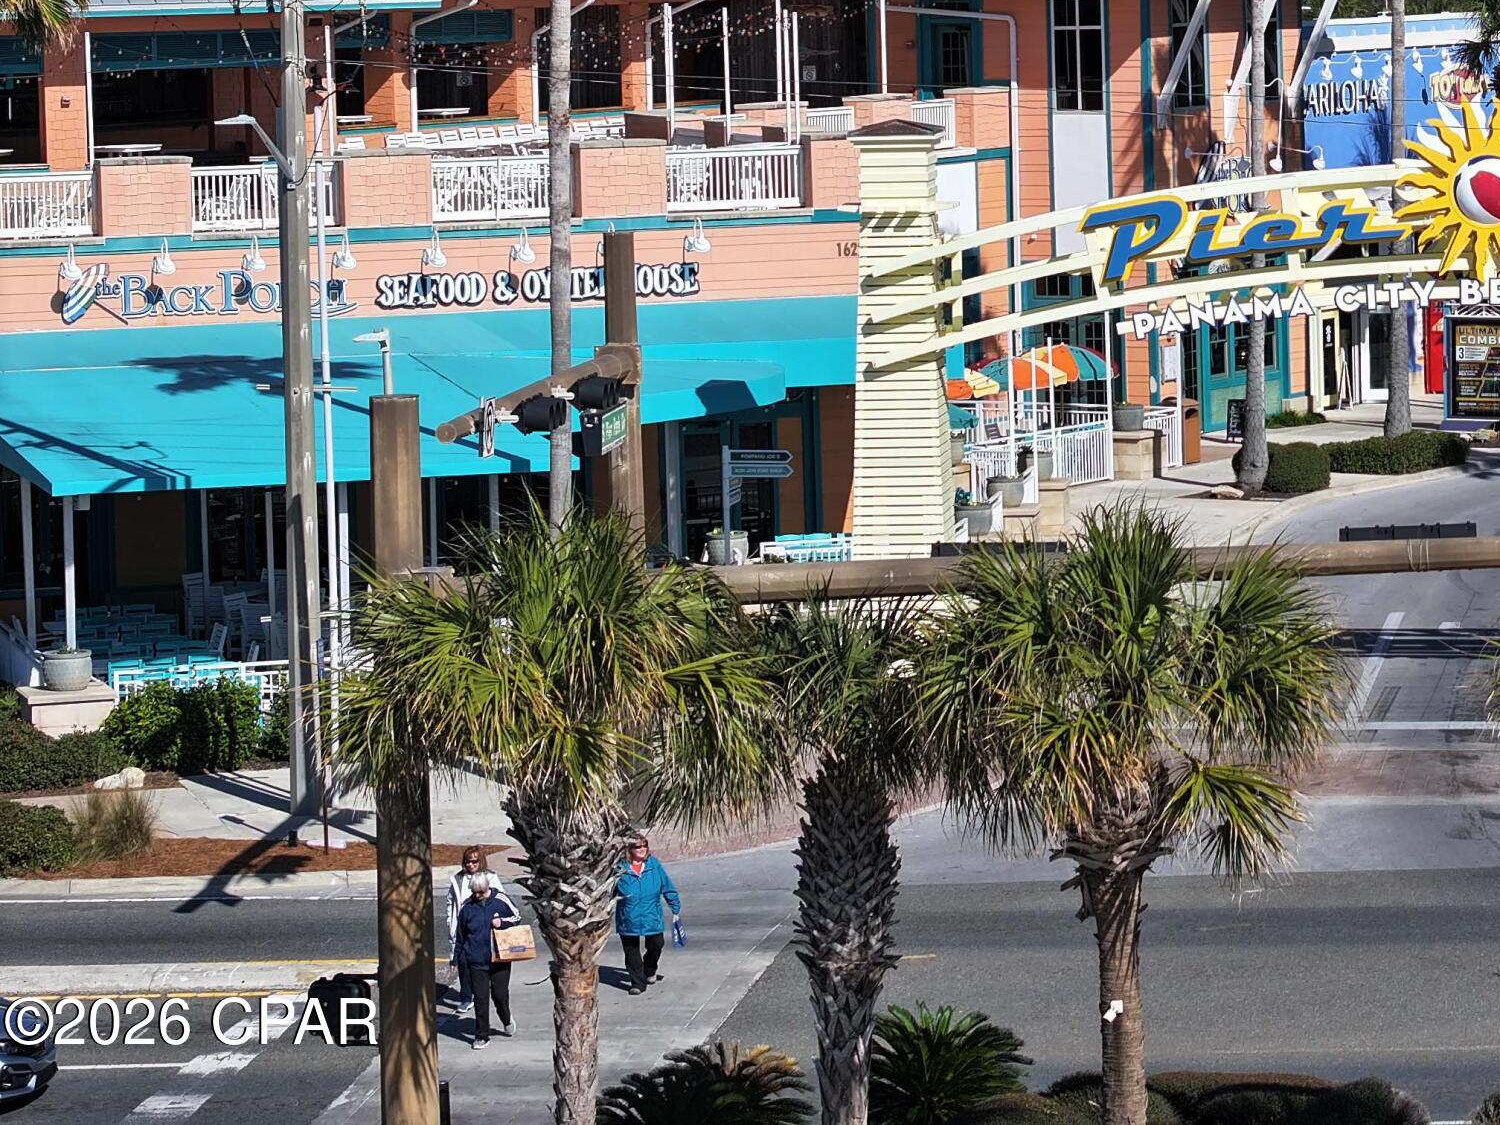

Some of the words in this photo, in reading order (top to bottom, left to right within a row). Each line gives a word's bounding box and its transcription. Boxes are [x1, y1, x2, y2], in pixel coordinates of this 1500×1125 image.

[1303, 79, 1380, 116] ARILOHA
[836, 241, 859, 257] 162
[1077, 195, 1412, 284] Pier
[96, 278, 121, 296] the
[119, 274, 216, 317] BACK
[219, 269, 350, 313] POH
[376, 272, 487, 308] SEAFOOD
[493, 269, 518, 305] &
[521, 265, 606, 302] OYTE
[1133, 286, 1315, 340] PANAMA
[1335, 279, 1437, 313] CITY
[1458, 347, 1465, 360] 3
